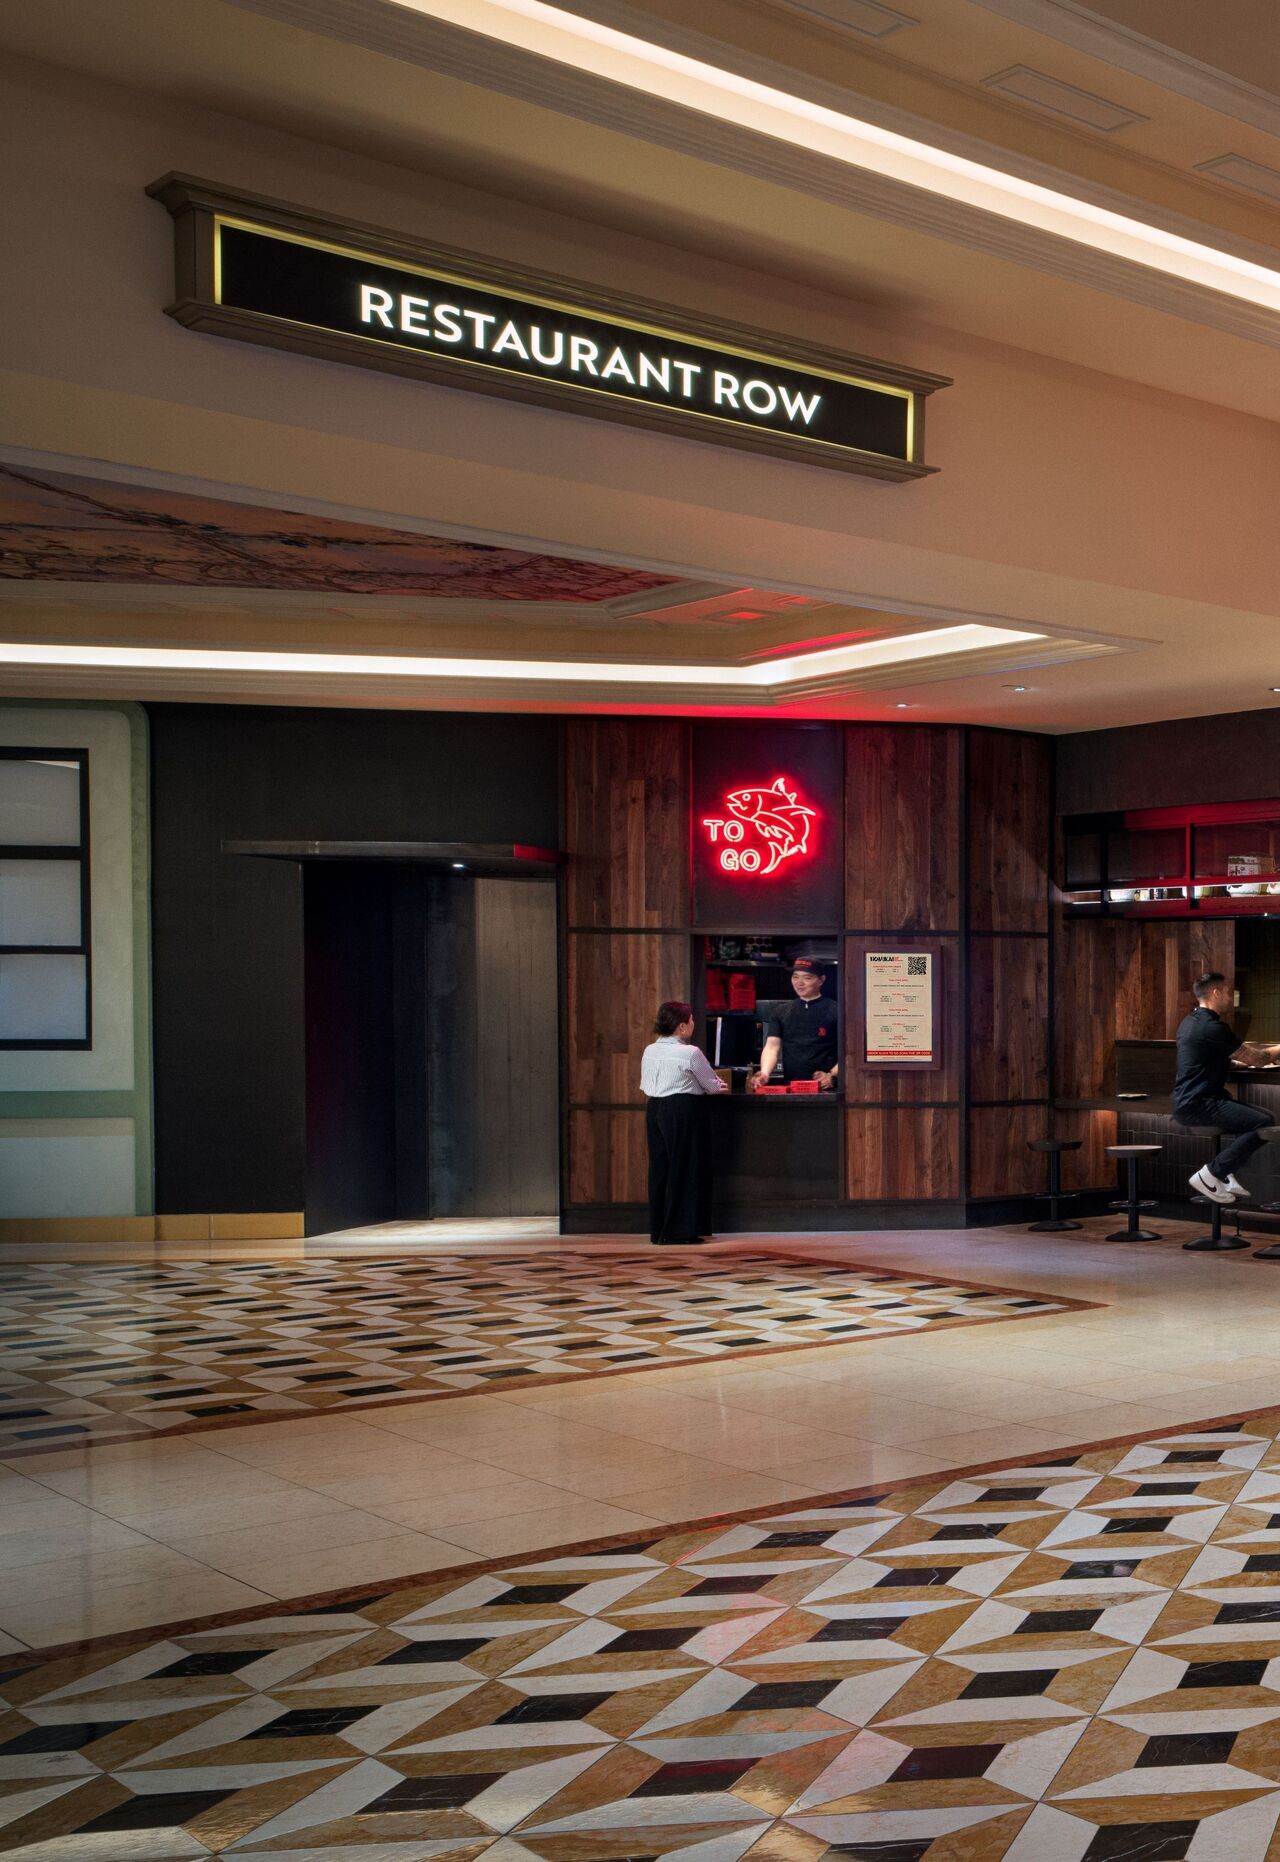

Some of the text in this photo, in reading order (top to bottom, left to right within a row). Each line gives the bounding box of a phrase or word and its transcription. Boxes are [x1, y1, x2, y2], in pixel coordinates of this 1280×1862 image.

[360, 284, 821, 425] RESTAURANT ROW
[703, 819, 745, 842] TO
[720, 848, 761, 871] GO
